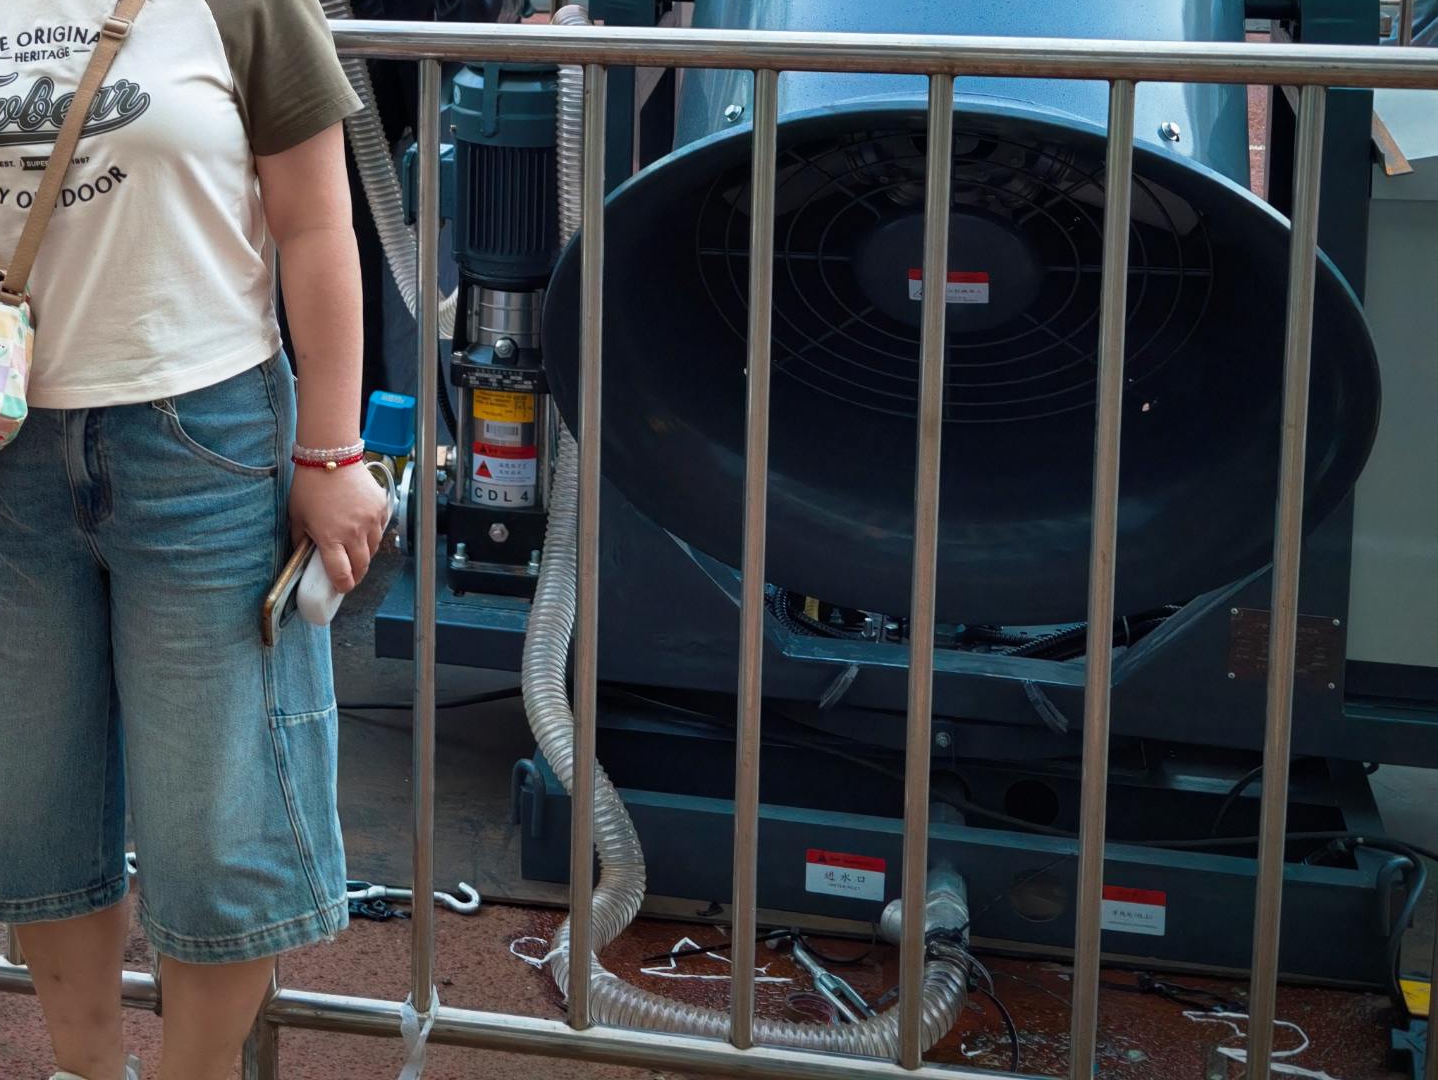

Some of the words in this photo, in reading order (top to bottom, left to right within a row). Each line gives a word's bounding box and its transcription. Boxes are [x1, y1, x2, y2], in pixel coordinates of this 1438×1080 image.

[17, 26, 102, 48] ORIGINA
[15, 47, 71, 63] HERITAGE
[16, 166, 128, 209] ODOOR
[824, 871, 866, 883] 进水口
